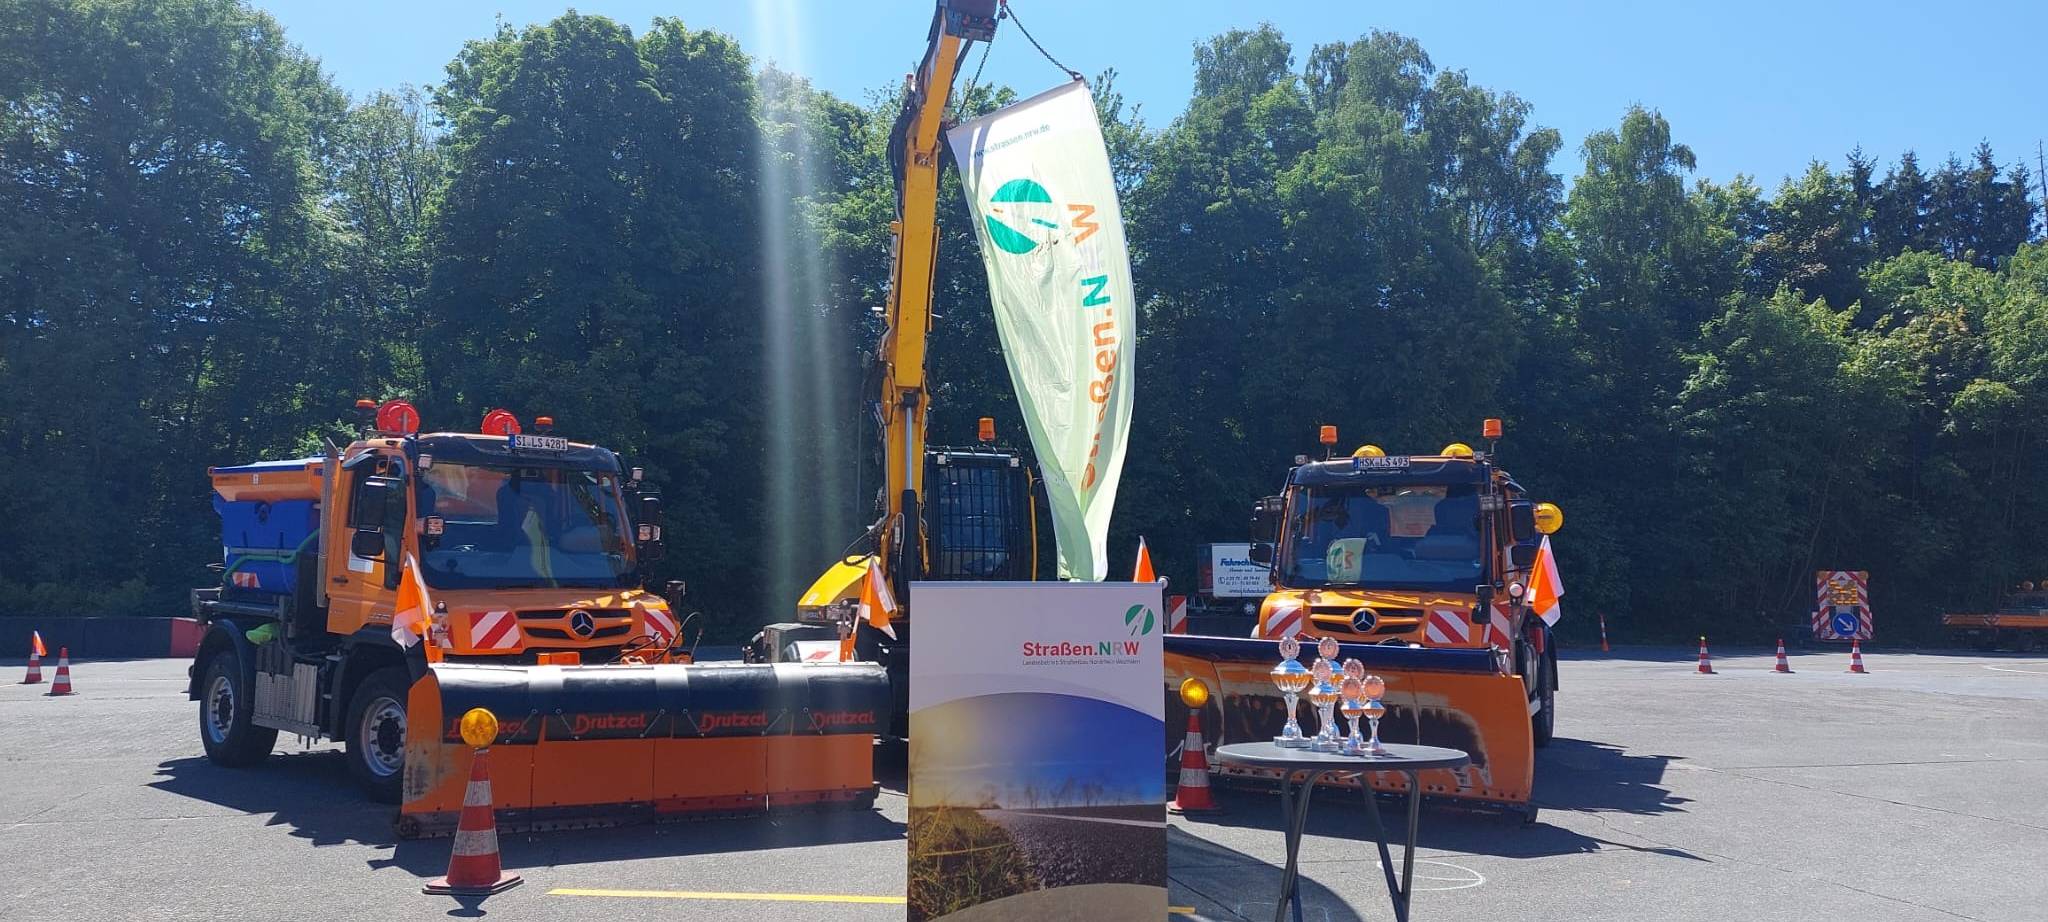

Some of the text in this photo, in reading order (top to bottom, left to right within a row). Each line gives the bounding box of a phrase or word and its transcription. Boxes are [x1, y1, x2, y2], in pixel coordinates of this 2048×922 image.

[516, 436, 567, 450] SI LS 4281
[1380, 458, 1391, 467] LS
[1023, 641, 1139, 657] Straßen.NRW
[572, 713, 647, 735] Drutzal
[699, 711, 769, 732] Drutzal
[809, 711, 876, 730] Drutzal
